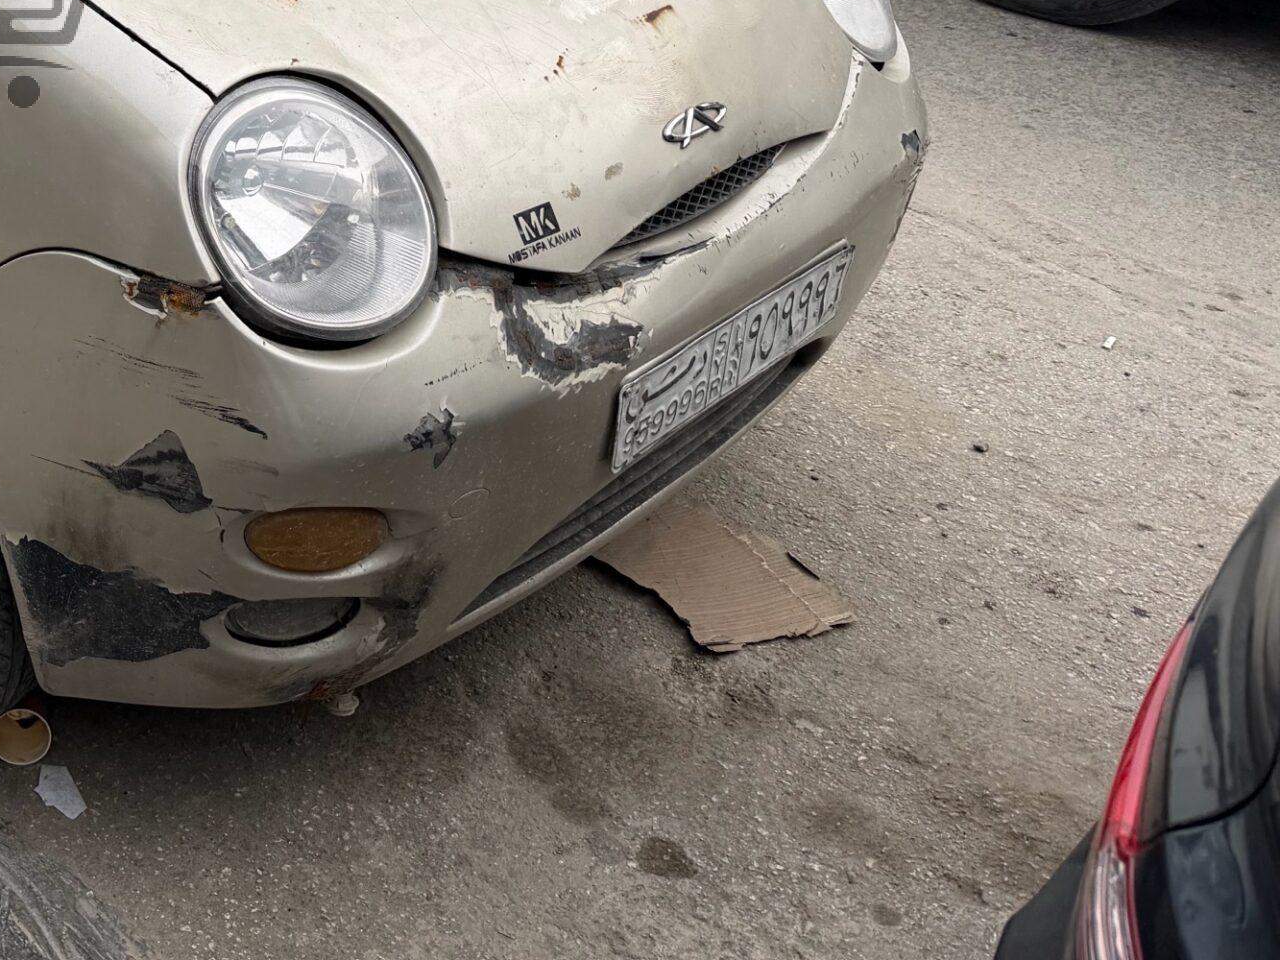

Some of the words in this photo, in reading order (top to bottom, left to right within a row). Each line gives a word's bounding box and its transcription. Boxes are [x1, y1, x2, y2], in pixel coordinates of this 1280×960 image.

[518, 207, 556, 241] MK
[507, 240, 548, 263] MOSTAFA
[547, 226, 582, 248] KANAAN
[622, 379, 707, 454] 959996
